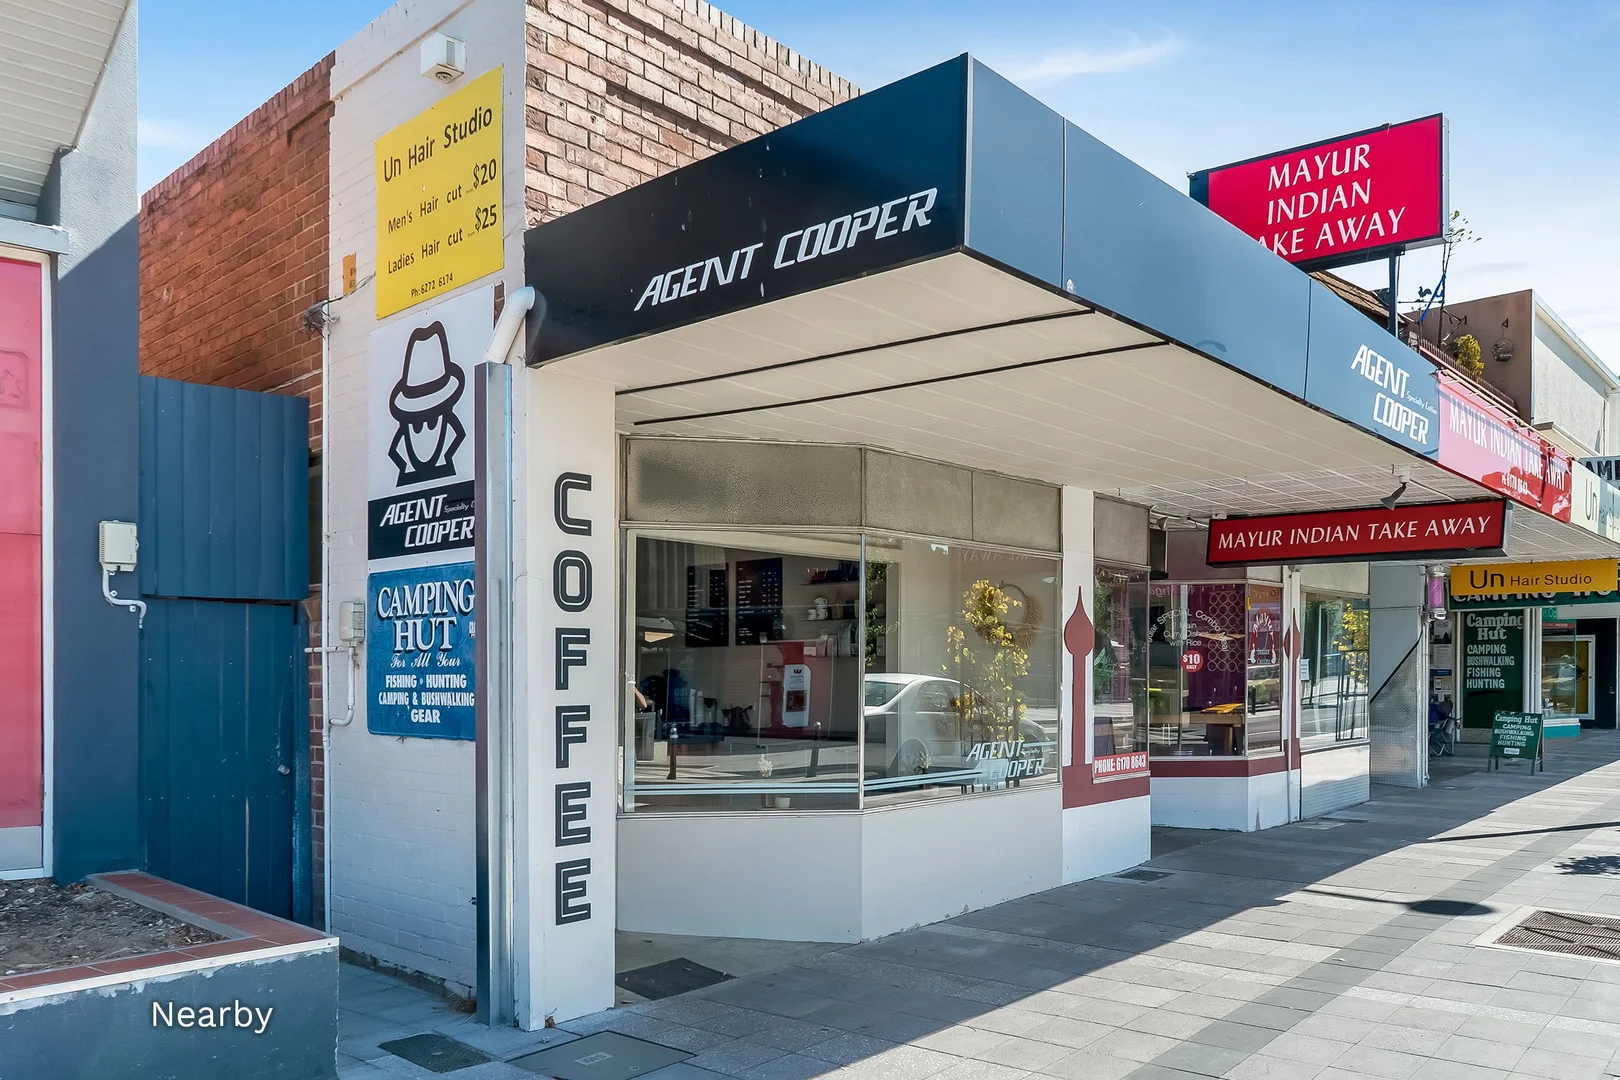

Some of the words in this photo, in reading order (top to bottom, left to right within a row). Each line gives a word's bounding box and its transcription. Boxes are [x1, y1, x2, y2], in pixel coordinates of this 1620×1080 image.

[383, 156, 401, 182] Un
[408, 136, 435, 169] Hair
[443, 106, 493, 149] Studio
[1268, 143, 1371, 192] MAYUR
[388, 210, 413, 234] Men's
[420, 196, 439, 217] Hair
[446, 184, 462, 204] cut
[473, 158, 497, 190] $20
[1267, 178, 1371, 226] INDIAN
[388, 252, 415, 274] Ladies
[421, 239, 440, 259] Hair
[447, 228, 463, 246] cut
[475, 203, 497, 233] $25
[1314, 206, 1406, 250] AWAY
[633, 242, 763, 312] AGENT
[773, 187, 938, 270] COOPER
[438, 272, 453, 287] 6174
[1350, 344, 1410, 399] AGENT
[1373, 391, 1429, 445] COOPER
[1449, 395, 1488, 449] MAYUR
[1490, 419, 1523, 470] INDIAN
[1524, 441, 1543, 480] TAKE
[1545, 454, 1565, 491] AWAY
[379, 493, 448, 527] AGENT
[404, 516, 475, 548] COOPER
[1218, 529, 1283, 550] MAYUR
[1289, 524, 1360, 545] INDIAN
[1368, 520, 1418, 541] TAKE
[1424, 515, 1492, 538] AWAY
[1469, 569, 1505, 589] Un
[1510, 575, 1540, 587] Hair
[1544, 573, 1593, 586] Studio
[378, 578, 475, 618] CAMPING
[1157, 608, 1192, 625] SPECL
[1466, 612, 1523, 630] Camping
[393, 616, 457, 651] HUT
[1477, 627, 1508, 640] Hut
[390, 652, 406, 669] For
[410, 652, 432, 668] All
[436, 651, 461, 667] Your
[1182, 653, 1201, 665] $10
[1467, 644, 1507, 655] CAMPING
[1466, 655, 1515, 666] BUSHWALKING
[385, 674, 417, 688] FISHING
[426, 674, 467, 688] HUNTING
[1466, 667, 1501, 678] FISHING
[1466, 678, 1505, 689] HUNTING
[378, 691, 409, 705] CAMPING
[412, 691, 419, 706] &
[421, 691, 475, 706] BUSHWALKING
[552, 472, 593, 926] COFFEE
[410, 708, 441, 723] GEAR
[1495, 713, 1523, 724] Camping
[1524, 715, 1539, 724] Hut
[1502, 723, 1532, 731] CAMPING
[965, 739, 1024, 762] AGENT
[1094, 757, 1116, 774] PHONE:
